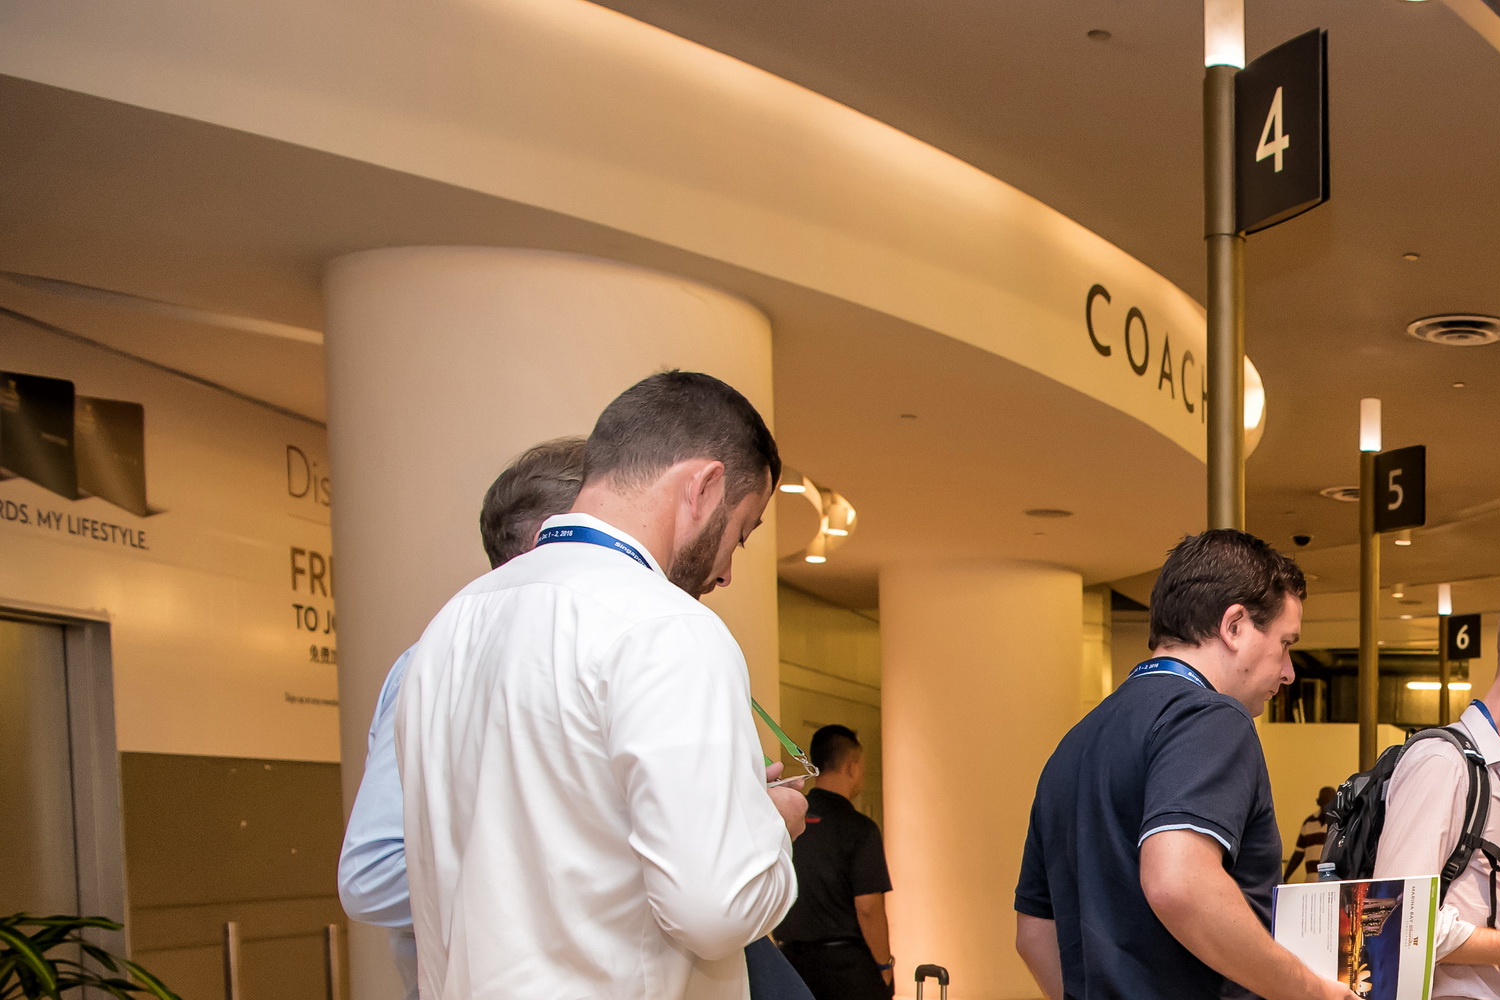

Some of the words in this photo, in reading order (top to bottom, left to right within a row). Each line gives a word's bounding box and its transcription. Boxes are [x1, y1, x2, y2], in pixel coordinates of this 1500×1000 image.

[1256, 86, 1290, 173] 4
[1387, 468, 1404, 511] 5
[37, 509, 62, 531] MY
[67, 514, 149, 550] LIFESTYLE.
[292, 604, 318, 632] TO
[1456, 624, 1470, 650] 6
